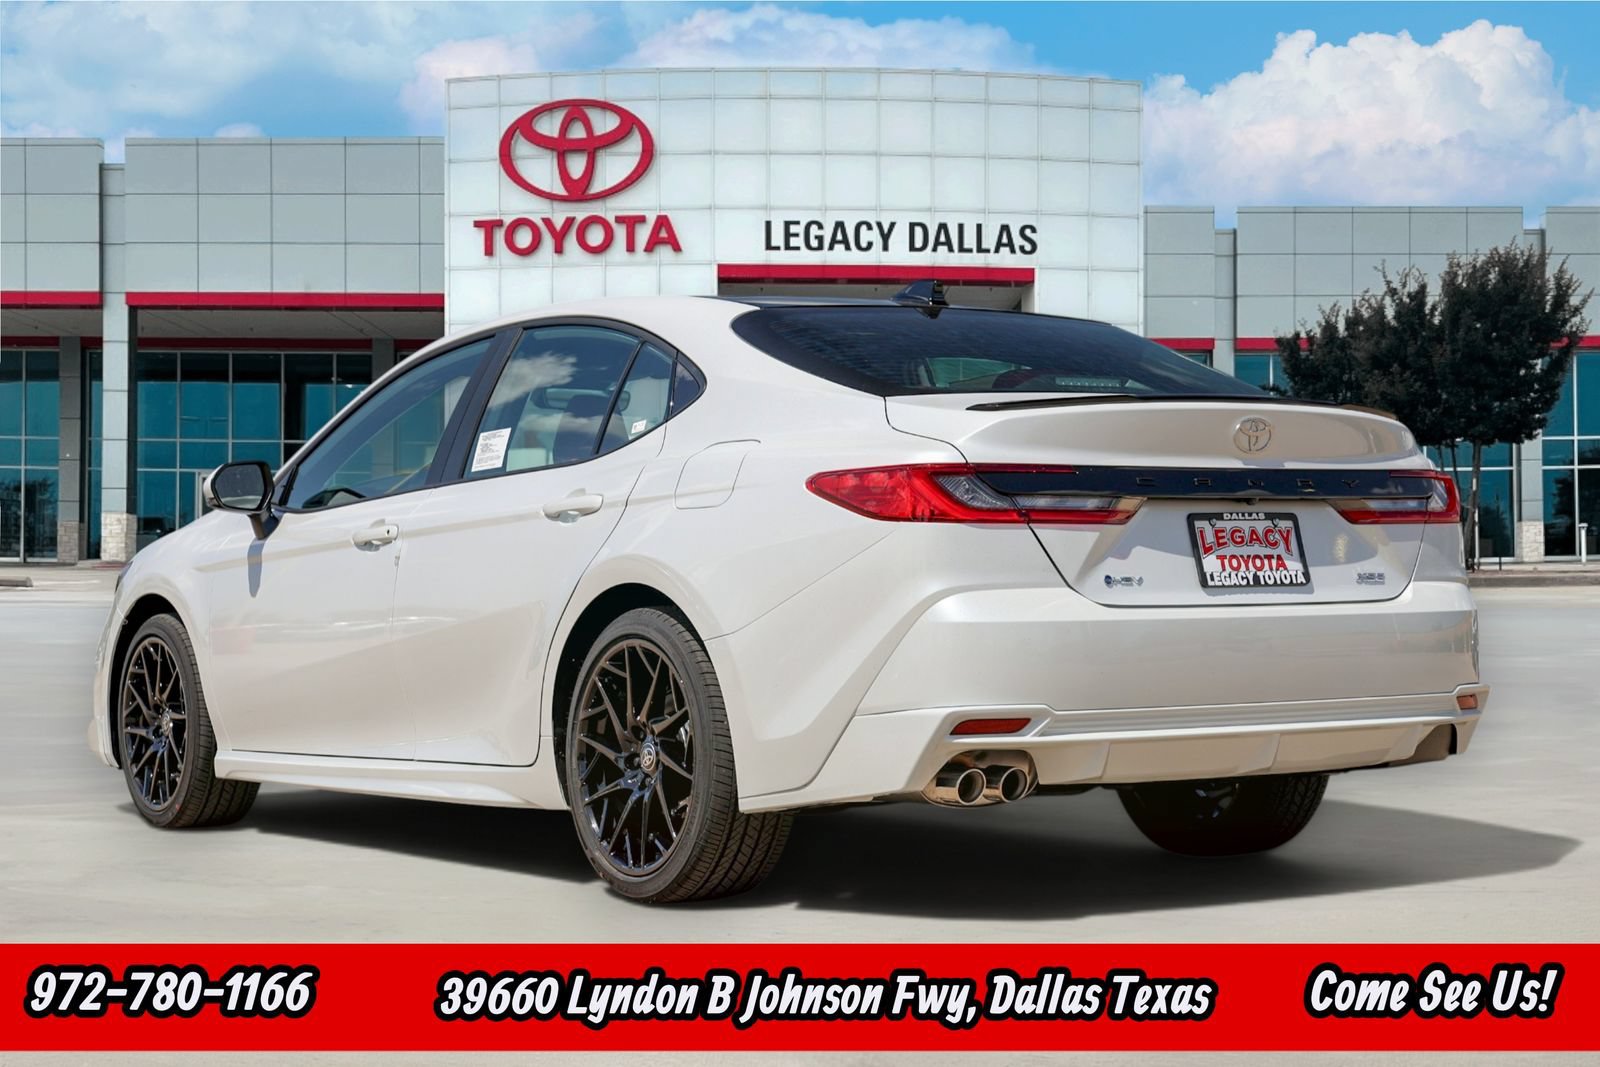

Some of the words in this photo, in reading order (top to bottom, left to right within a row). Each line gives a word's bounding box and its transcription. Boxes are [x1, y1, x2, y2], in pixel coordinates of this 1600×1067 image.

[474, 214, 682, 257] TOYOTA
[765, 220, 897, 252] LEGACY
[908, 221, 1038, 256] DALLAS
[1136, 477, 1359, 488] CAMRY
[1222, 512, 1266, 520] DALLAS
[1197, 526, 1293, 559] LEGACY
[1216, 554, 1288, 572] TOYOTA
[1206, 571, 1253, 586] LEGACY
[1257, 570, 1306, 585] TOYOTA
